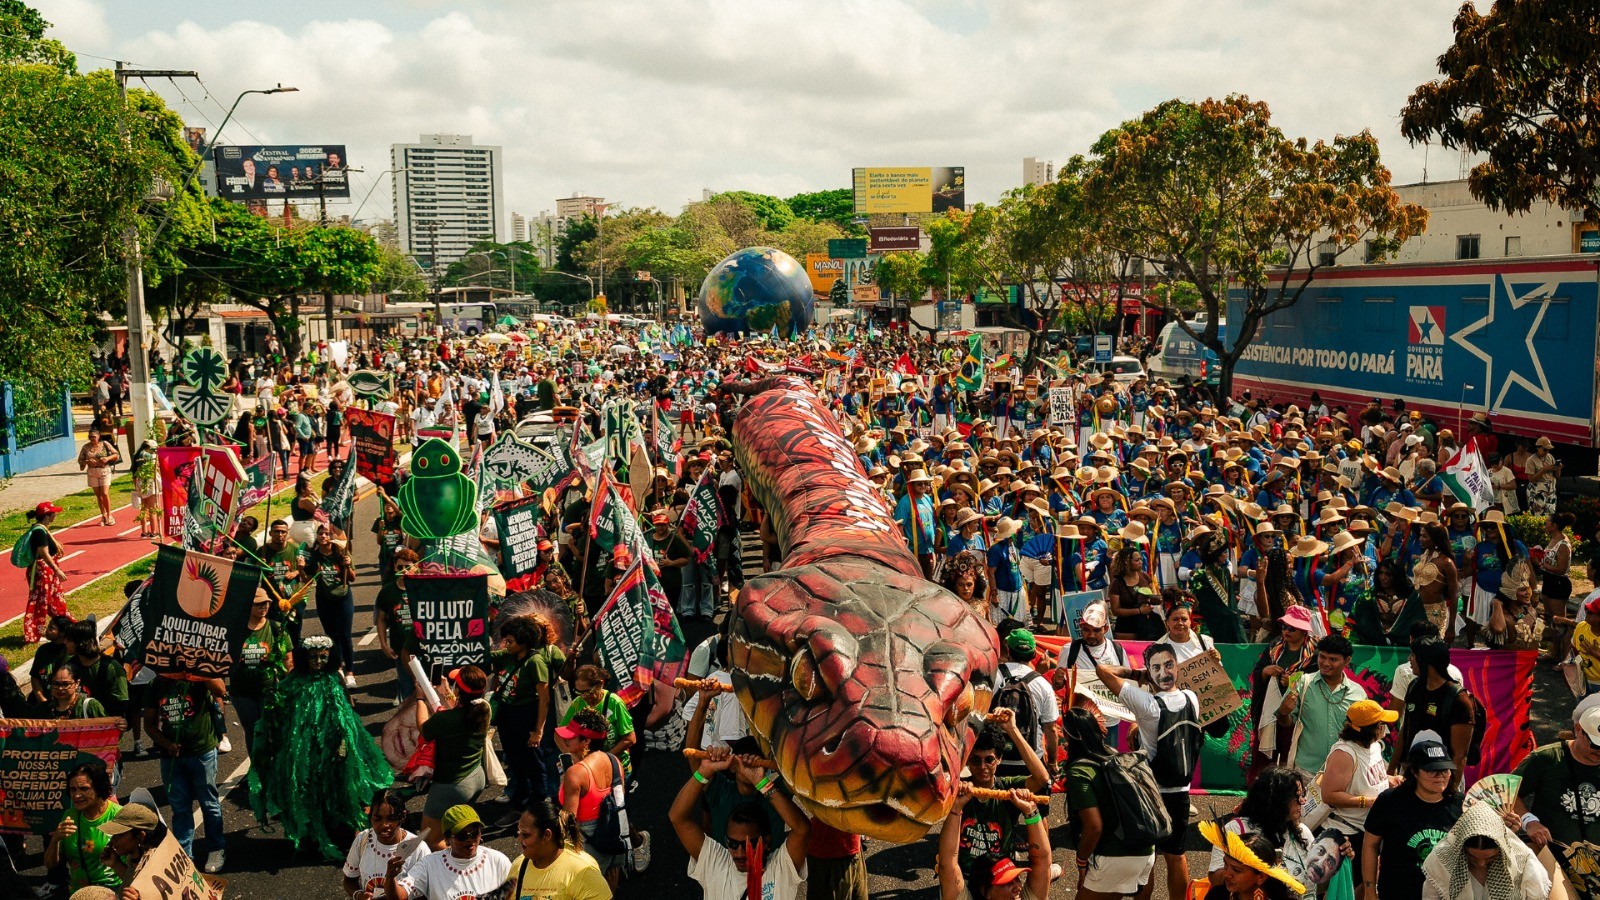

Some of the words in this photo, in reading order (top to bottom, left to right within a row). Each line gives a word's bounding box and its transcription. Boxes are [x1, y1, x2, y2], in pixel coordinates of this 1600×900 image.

[226, 176, 248, 185] FÁBIO
[1407, 346, 1433, 354] GOVERNO
[1292, 350, 1313, 367] POR
[1316, 350, 1347, 370] TODO
[1350, 352, 1359, 371] O
[1360, 350, 1395, 375] PARÁ
[700, 489, 710, 503] EU
[172, 506, 177, 515] O
[170, 517, 180, 526] NA
[596, 515, 614, 534] CLIM
[508, 524, 519, 535] DAS
[417, 601, 434, 620] EU
[440, 600, 473, 619] LUTO
[609, 609, 617, 620] É
[617, 592, 636, 627] NOSSAS
[161, 615, 228, 640] AQUILOMBAR
[426, 621, 462, 640] PELA
[600, 611, 610, 639] CLIMA
[154, 627, 162, 640] E
[163, 630, 202, 648] ALDEAR
[204, 638, 229, 653] PELA
[419, 640, 485, 653] MAZÔNIA
[604, 634, 617, 650] DO
[612, 618, 638, 661] DEFENDER
[146, 640, 233, 663] AMAZÔNIA
[145, 653, 170, 667] DE
[608, 647, 634, 690] PLANETA
[1192, 670, 1210, 683] SEM
[1212, 667, 1219, 675] A
[2, 750, 78, 759] PROTEGER
[18, 761, 59, 770] NOSSAS
[0, 770, 68, 780] LORESTA
[4, 781, 67, 790] DEFENDE
[47, 791, 62, 799] DO
[4, 802, 64, 810] PLANETA
[152, 875, 173, 900] A
